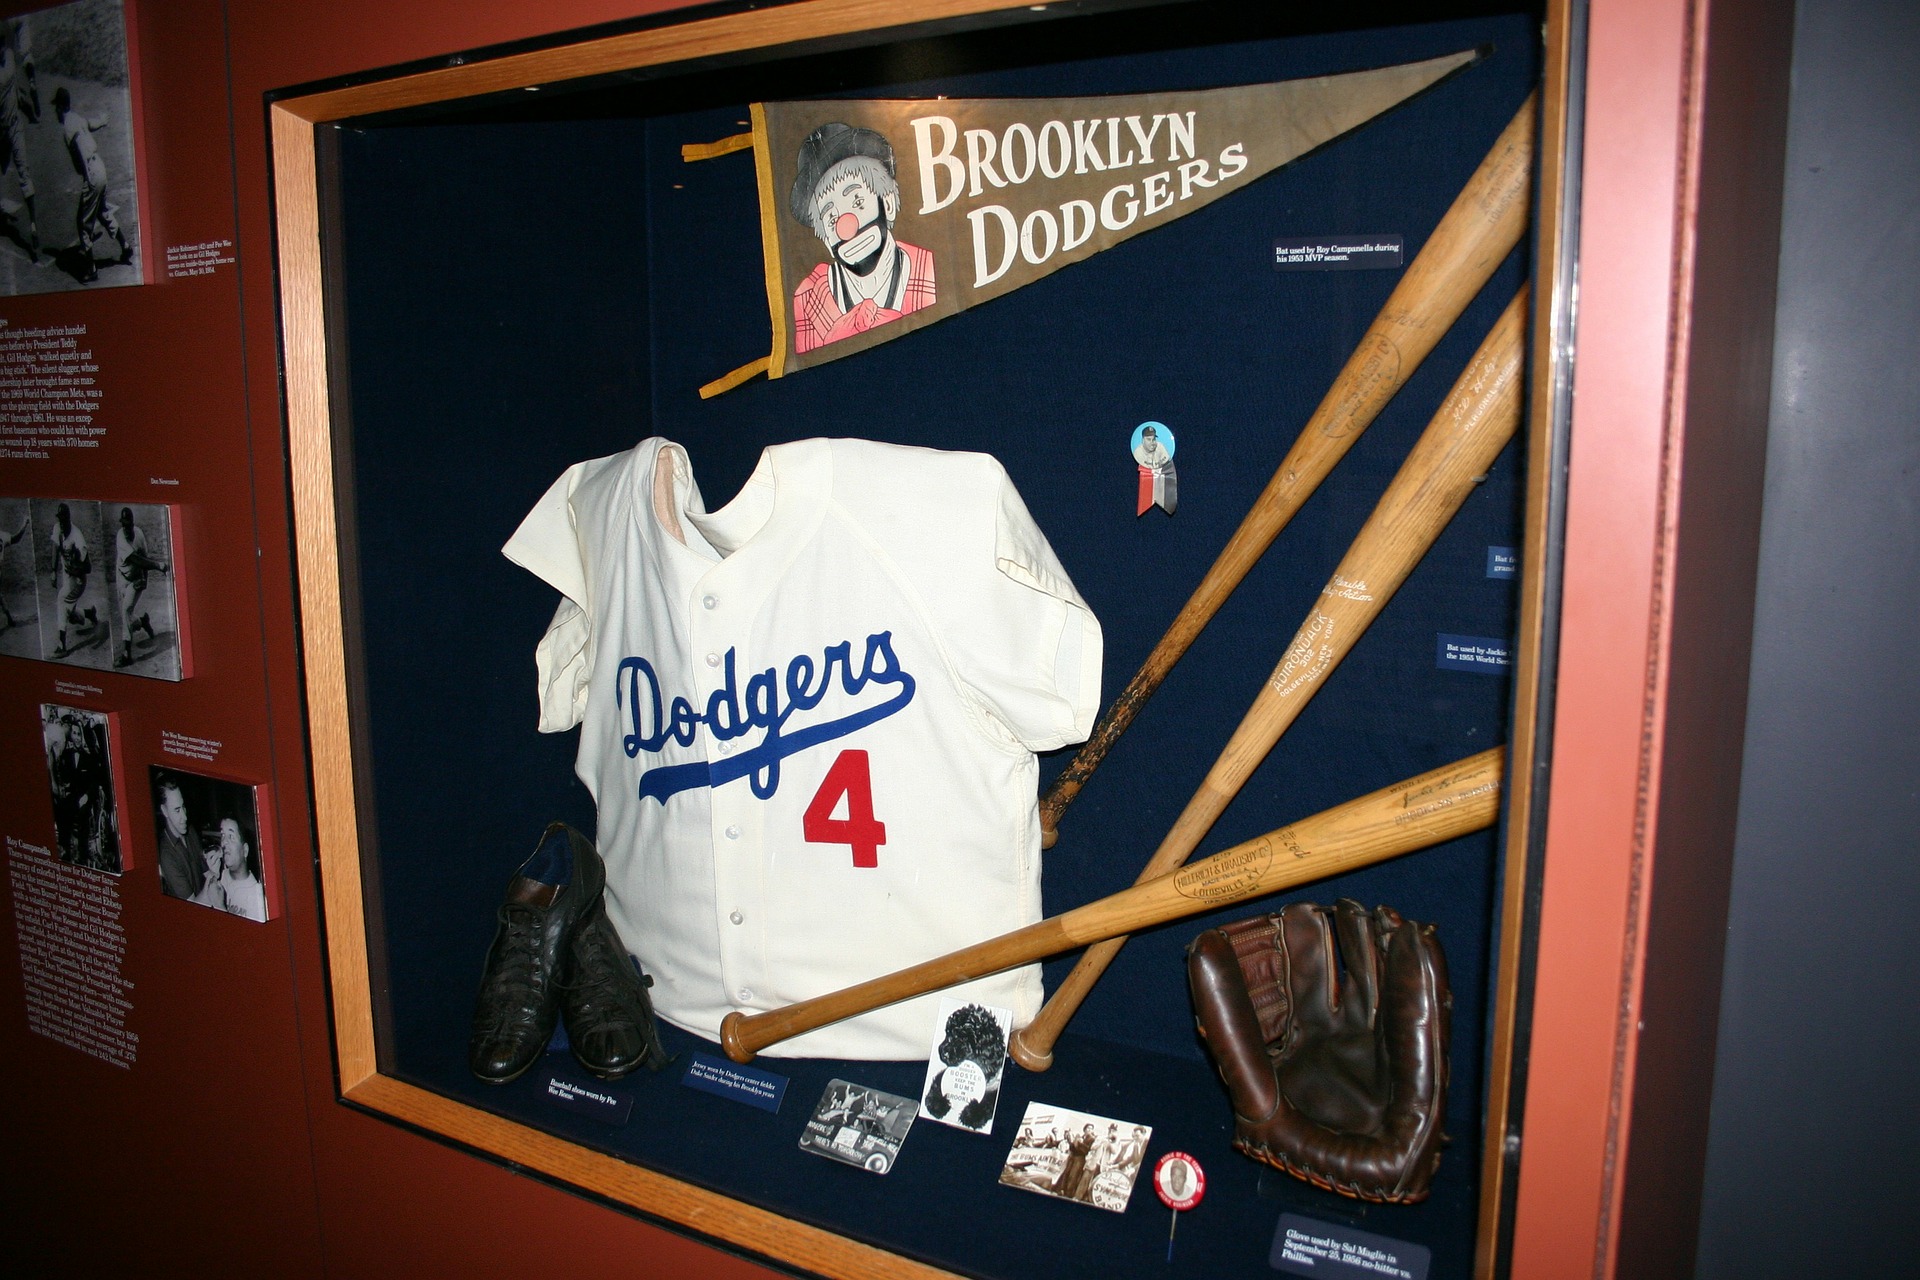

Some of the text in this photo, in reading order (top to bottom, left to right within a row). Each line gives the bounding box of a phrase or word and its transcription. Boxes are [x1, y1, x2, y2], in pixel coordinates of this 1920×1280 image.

[910, 112, 1196, 216] BROOKLYN
[966, 143, 1248, 289] DODGERS
[1276, 244, 1399, 256] Bat used by Roy Campanella during
[1276, 254, 1350, 263] his 1953 MVP season.
[33, 339, 60, 350] President
[80, 349, 92, 360] and
[31, 365, 41, 374] The
[23, 389, 40, 399] World
[40, 389, 69, 401] Champion
[39, 401, 51, 411] field
[75, 401, 100, 413] Dodgers
[1495, 555, 1507, 563] Bat
[1273, 612, 1327, 692] ADIRONDACK
[1318, 643, 1328, 662] NEW
[1447, 643, 1507, 656] Bat used by Jackie
[1299, 649, 1315, 667] 302
[1446, 652, 1495, 664] the 1955 World
[615, 630, 916, 806] Dodgers
[803, 749, 887, 868] 4
[725, 1070, 744, 1081] Dodgers
[741, 1084, 762, 1095] Brooklyn
[954, 1083, 974, 1092] BUMS
[1286, 1229, 1397, 1264] Glove used by Sal Maglie in
[1281, 1249, 1314, 1265] Phillies.
[1284, 1239, 1411, 1279] September 25, 1956 no-hitter vs.
